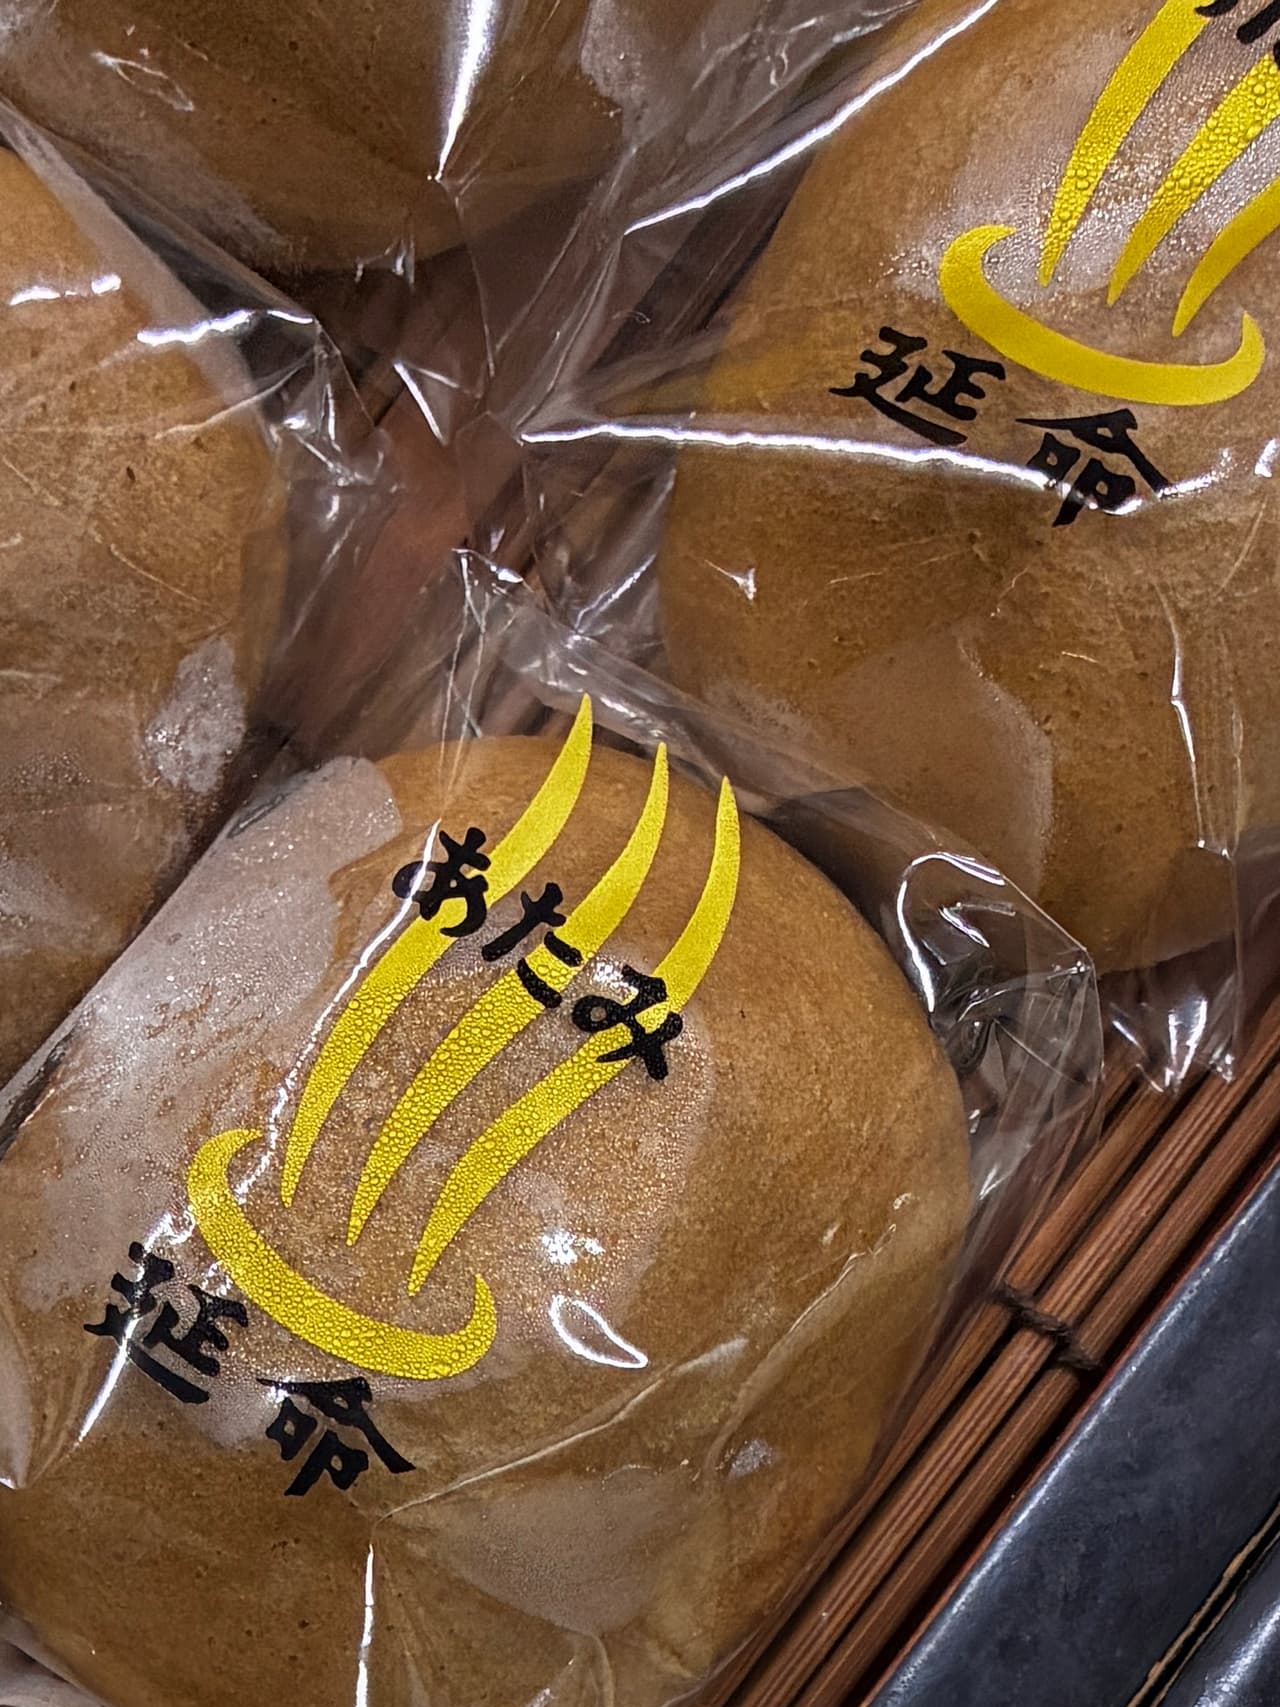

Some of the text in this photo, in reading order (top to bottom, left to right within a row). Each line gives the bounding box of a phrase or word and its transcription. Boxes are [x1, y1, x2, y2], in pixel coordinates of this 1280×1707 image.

[827, 324, 1174, 529] 延命
[390, 826, 684, 1083] あたみ
[81, 1240, 418, 1498] 延命
